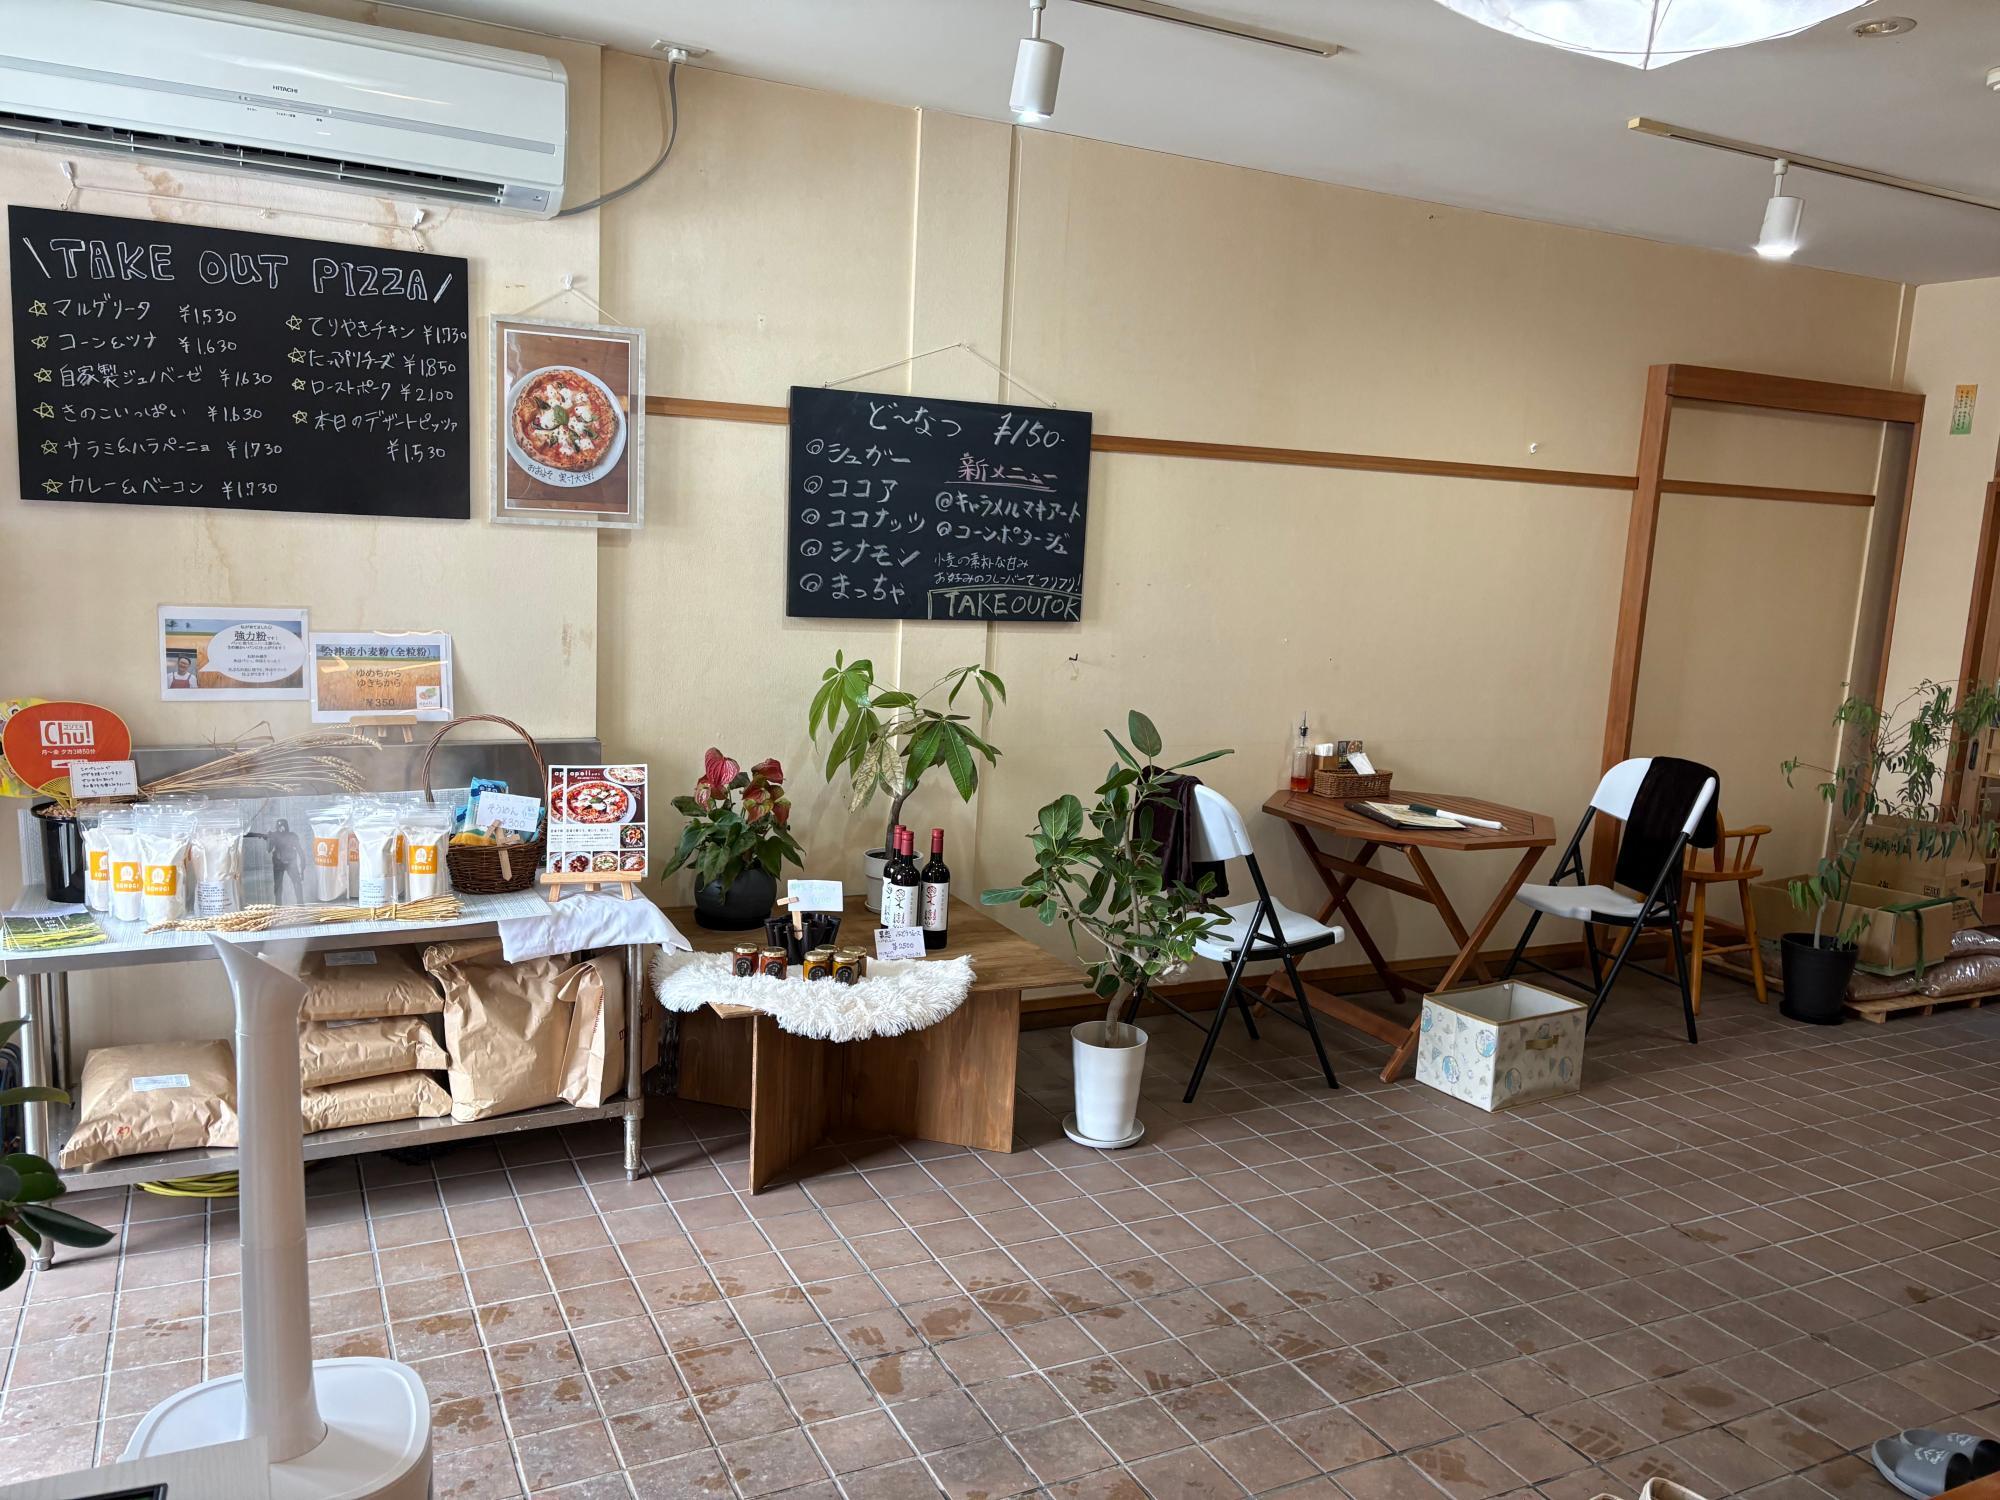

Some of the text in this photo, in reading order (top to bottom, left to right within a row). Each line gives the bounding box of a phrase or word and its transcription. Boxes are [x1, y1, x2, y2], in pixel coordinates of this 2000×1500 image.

[272, 85, 298, 94] HITACHI
[50, 238, 428, 301] TAKE OUT PIZZA
[53, 292, 151, 320] マルゲリータ
[308, 316, 415, 340] てりやきチキン
[59, 331, 157, 351] コーン&ツナ
[309, 349, 395, 370] たっぷりチーズ
[311, 379, 392, 400] ローストポーク
[62, 403, 186, 422] きのこいっぱい
[315, 409, 458, 432] 本日のデザートピッツァ
[64, 437, 210, 459] サラミ&ハラペーニョ
[828, 443, 911, 466] シュガー
[958, 451, 1058, 481] 新メニュー
[68, 475, 204, 495] カレー&ベーコン
[828, 479, 898, 503] ココア
[954, 490, 1081, 523] キャラメルマキアート
[827, 507, 925, 534] ココナッツ
[955, 524, 1069, 554] コーンポタージュ
[830, 538, 921, 567] シナモン
[934, 552, 1029, 571] 小麦の素朴な甘み
[831, 572, 905, 605] まっちゃ
[44, 721, 91, 745] Chu!
